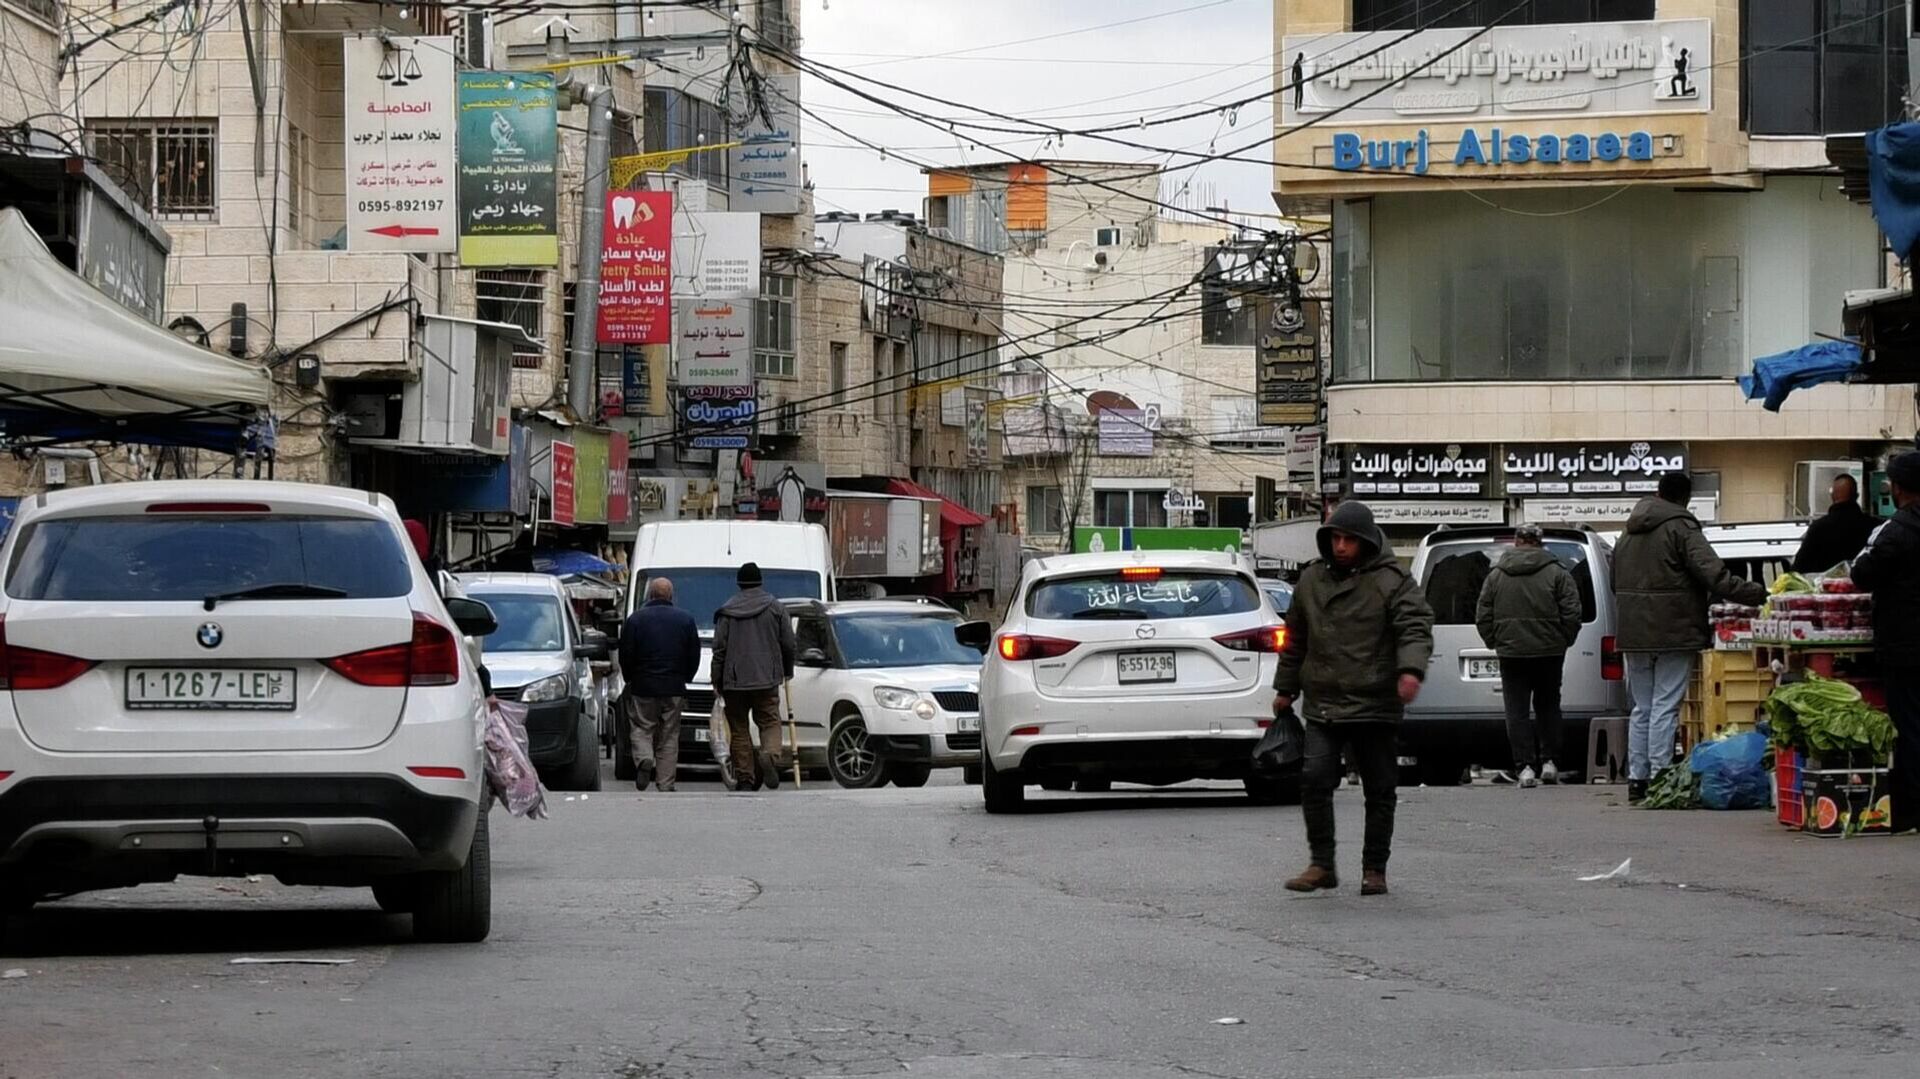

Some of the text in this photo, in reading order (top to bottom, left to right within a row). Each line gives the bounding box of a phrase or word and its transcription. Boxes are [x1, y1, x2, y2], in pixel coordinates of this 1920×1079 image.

[367, 101, 431, 116] المحامية
[390, 131, 413, 141] محمد
[1332, 128, 1654, 174] Burj Alsaaea
[358, 200, 444, 212] 0595-892197
[510, 200, 544, 217] جهاد
[616, 233, 645, 248] عيادة
[601, 247, 666, 262] بريتي سماي
[633, 263, 667, 277] Smile
[639, 279, 664, 294] لطب
[683, 326, 709, 341] توليد
[1351, 452, 1390, 477] الليث
[1391, 449, 1413, 478] أبو
[1414, 453, 1486, 478] مجوهرات
[1503, 447, 1684, 477] مجوهرات أبو الليث
[1088, 583, 1120, 608] الله
[272, 687, 281, 698] P
